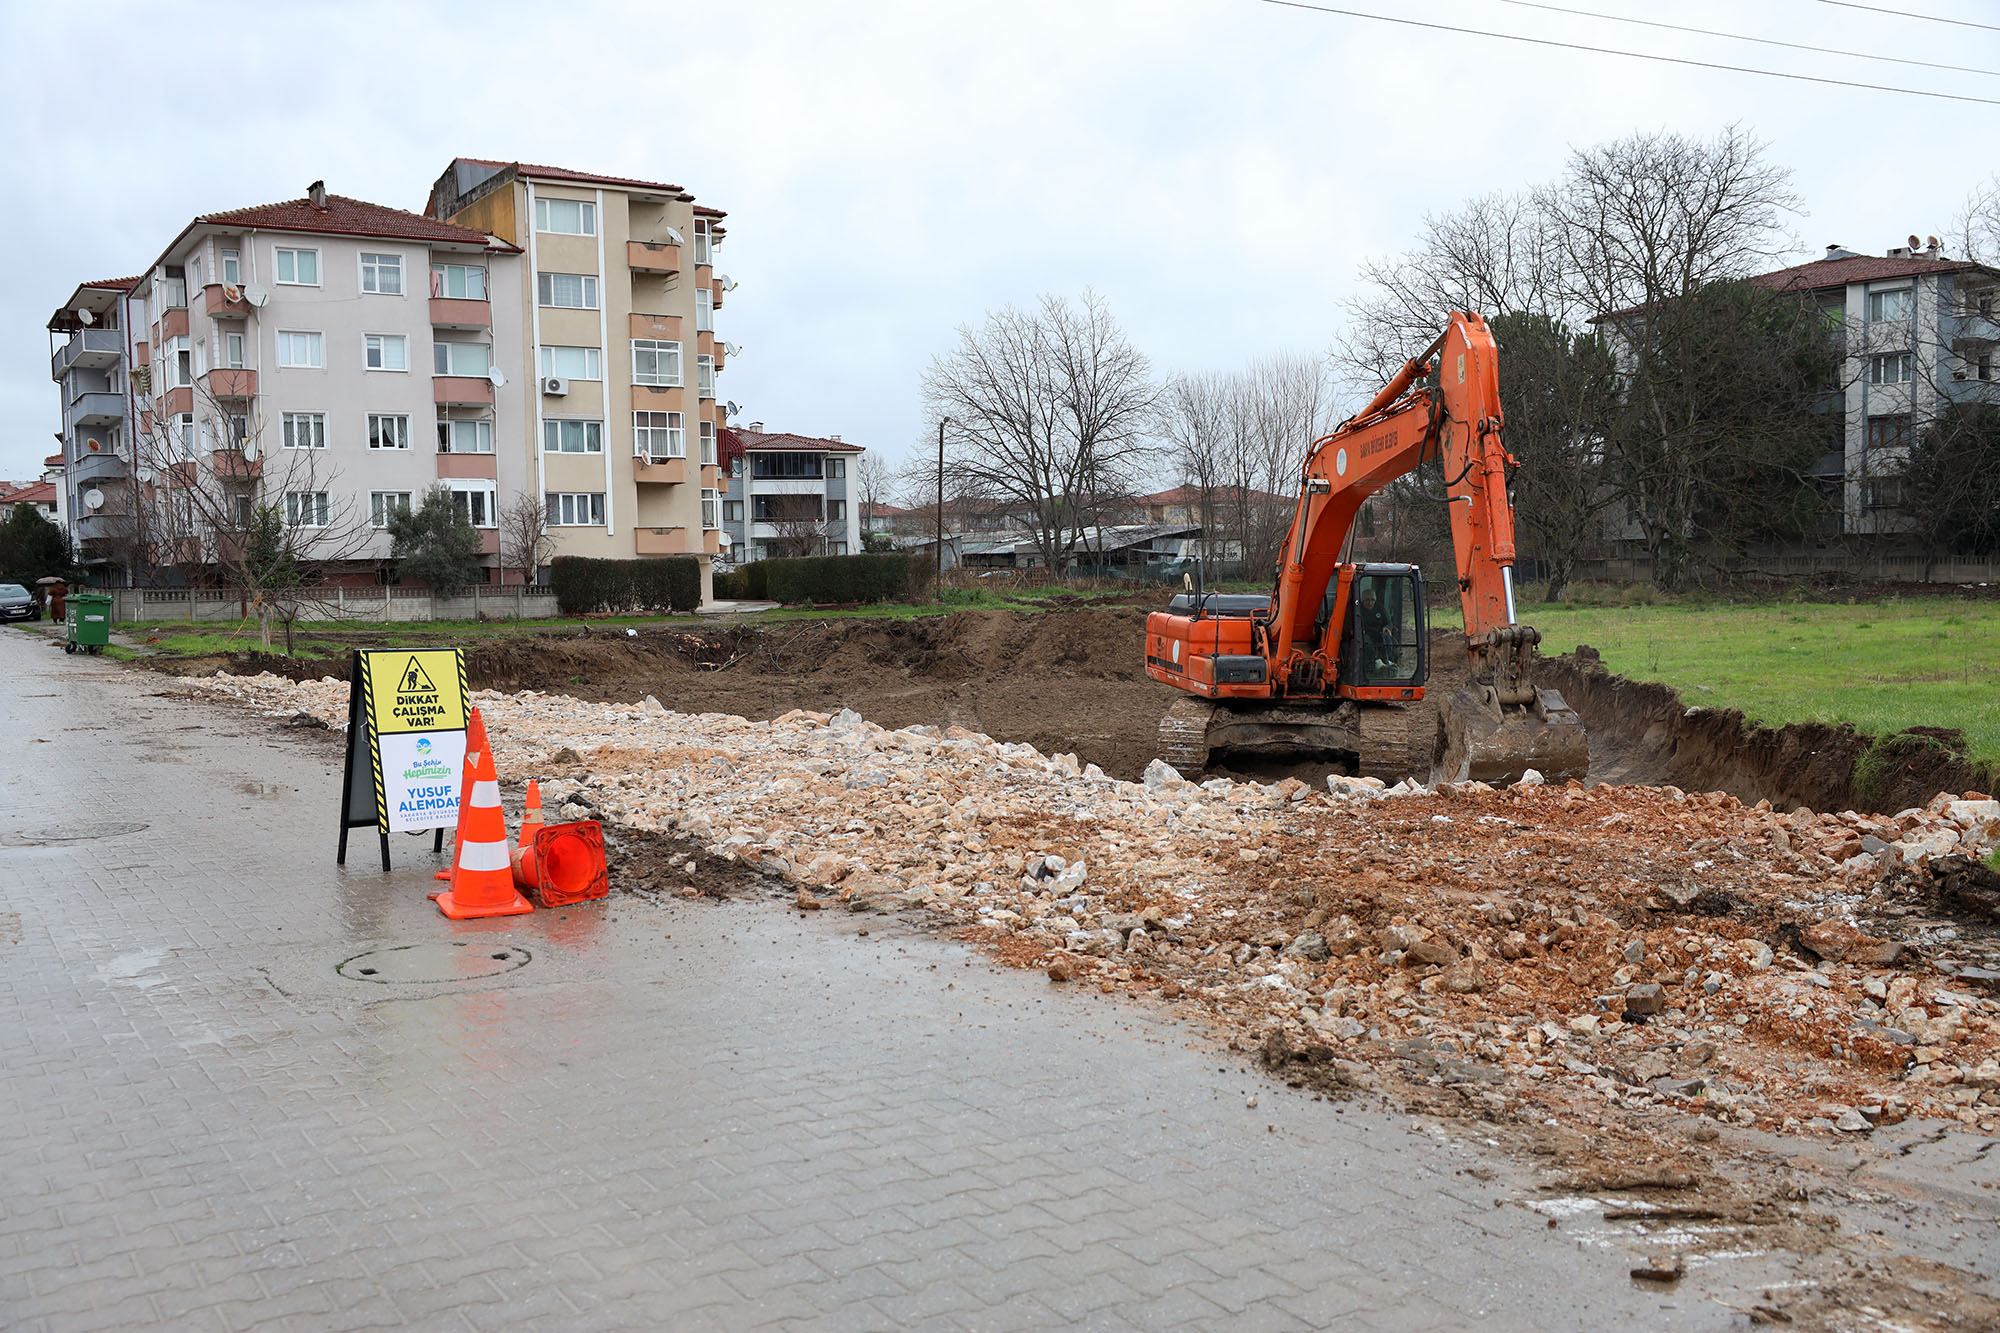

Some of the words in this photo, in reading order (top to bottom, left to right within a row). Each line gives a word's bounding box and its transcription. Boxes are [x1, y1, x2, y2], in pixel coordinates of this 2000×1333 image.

[392, 705, 446, 718] ÇALIŞMA
[406, 717, 435, 727] VAR!
[402, 765, 451, 780] Hepimizin
[407, 785, 452, 799] YUSUF
